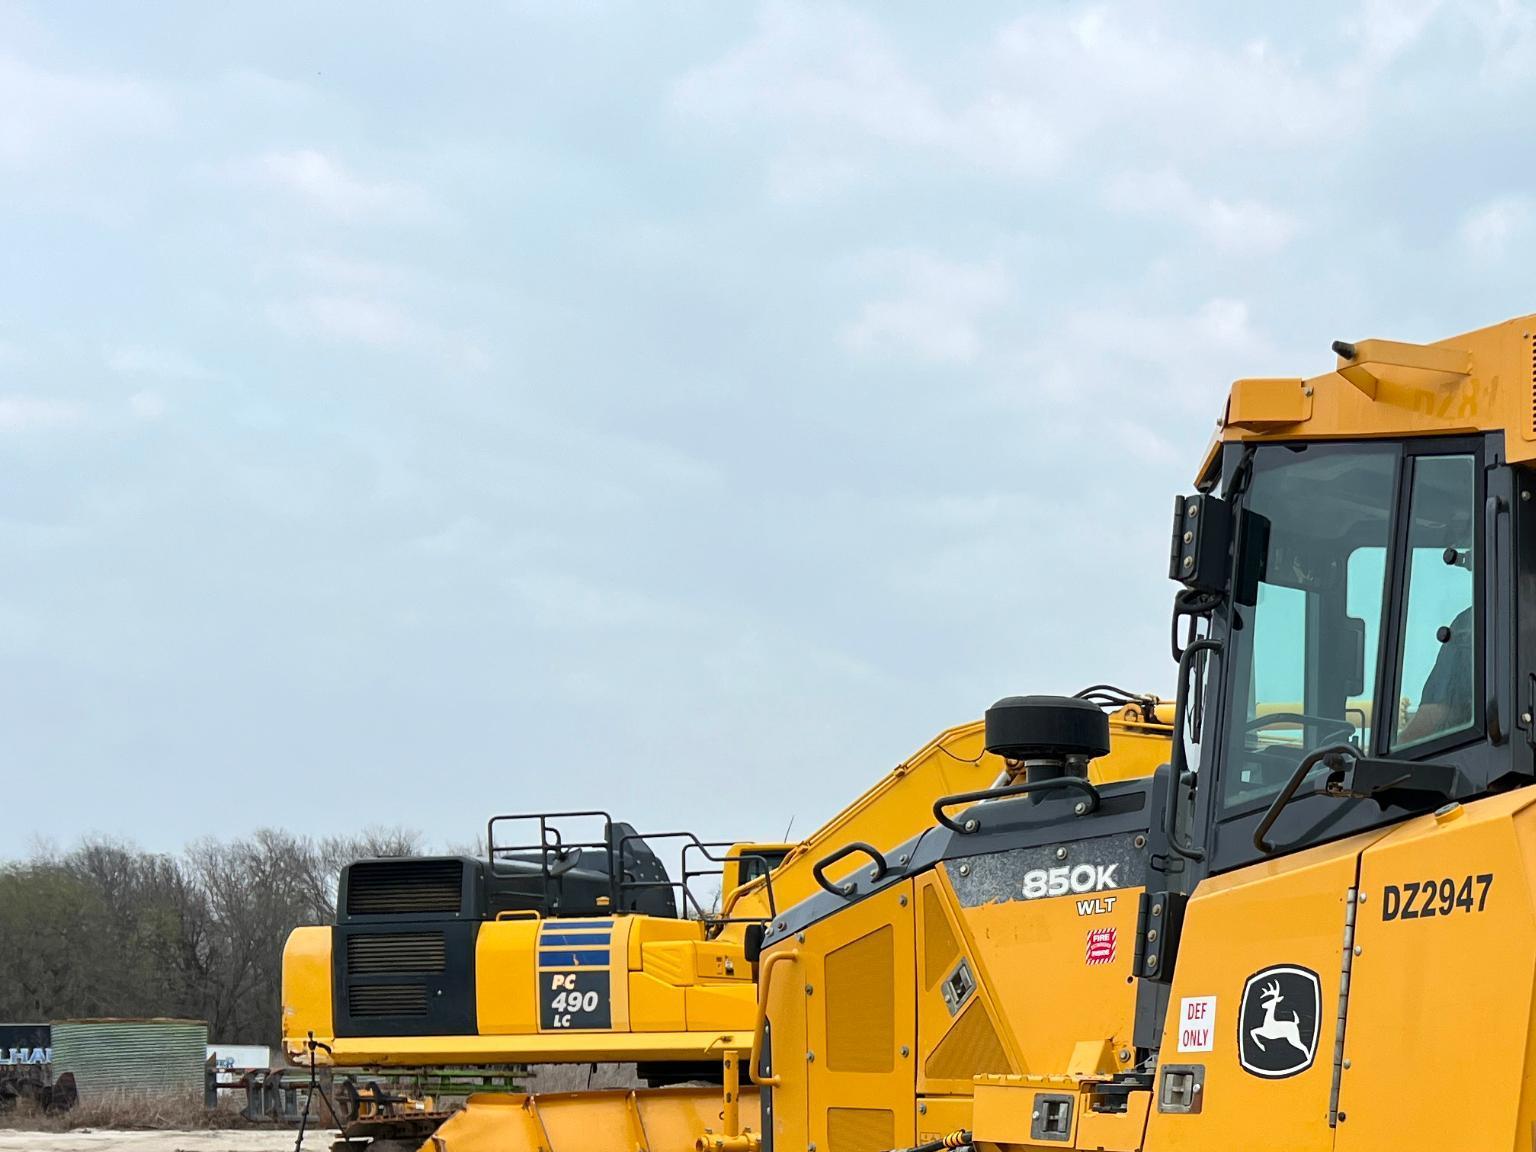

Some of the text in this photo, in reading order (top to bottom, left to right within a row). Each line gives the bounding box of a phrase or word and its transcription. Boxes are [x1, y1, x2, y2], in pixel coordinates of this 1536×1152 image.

[1021, 863, 1119, 899] 850K
[1076, 896, 1117, 916] WLT
[1382, 873, 1493, 921] DZ2947
[551, 973, 577, 990] PC
[551, 991, 599, 1012] 490
[1187, 1002, 1207, 1020] DEF
[553, 1014, 571, 1027] LC
[1182, 1029, 1209, 1047] ONLY
